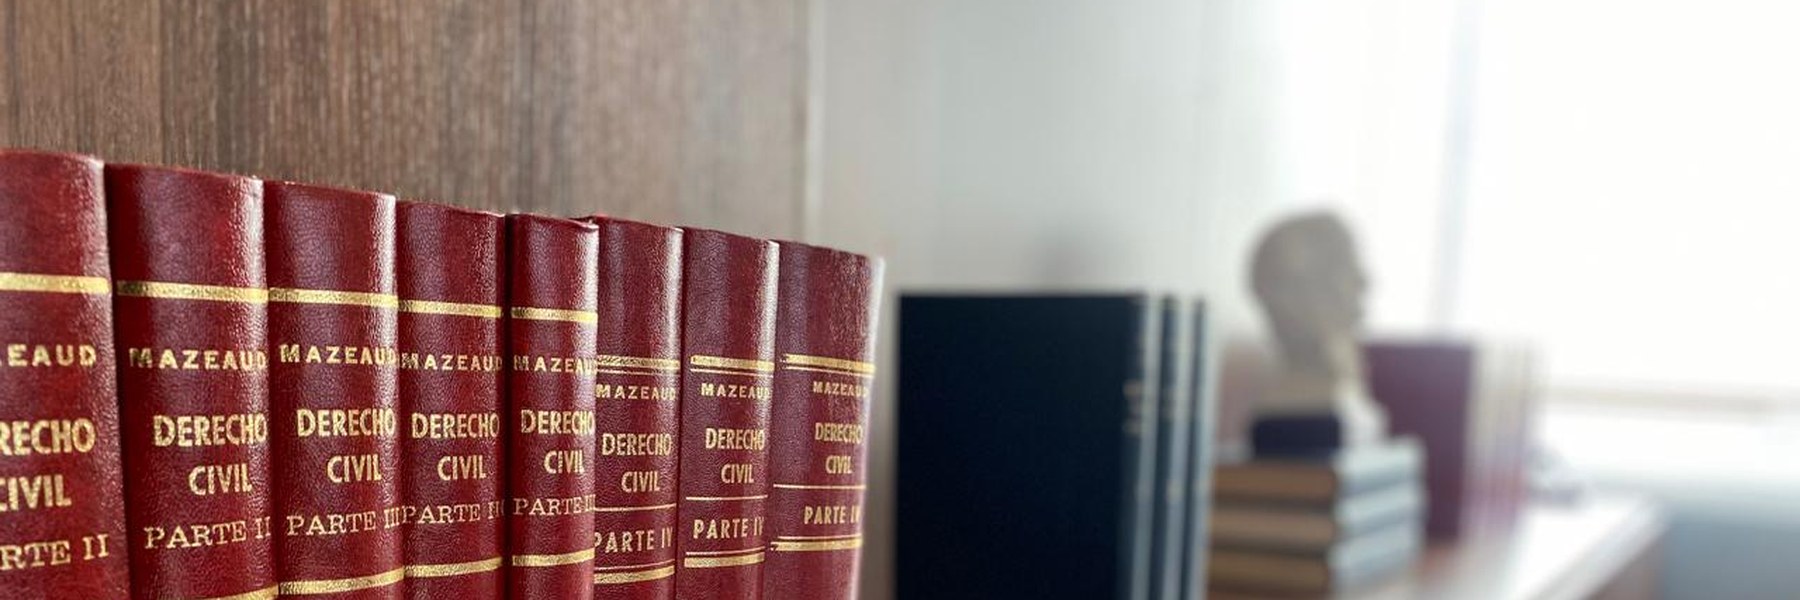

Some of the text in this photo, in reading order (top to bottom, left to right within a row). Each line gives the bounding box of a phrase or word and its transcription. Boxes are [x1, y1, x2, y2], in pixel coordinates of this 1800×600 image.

[0, 343, 97, 367] EAUD
[129, 347, 268, 370] MAZEAUD
[279, 344, 397, 366] MAZEAUD
[401, 351, 503, 372] MAZEAUD
[596, 383, 676, 401] MAZEAUD
[700, 382, 770, 401] MAZEAUD
[813, 381, 869, 398] MAZEAUD
[153, 413, 268, 447] DERECHO
[297, 408, 396, 437] DERECHO
[411, 413, 500, 439] DERECHO
[521, 409, 596, 435] DERECHO
[815, 422, 864, 444] DERECHO
[602, 433, 672, 455] DERECHO
[705, 427, 765, 451] DERECHO
[326, 455, 382, 484] CIVIL
[437, 454, 487, 481] CIVIL
[543, 450, 585, 474] CIVIL
[825, 455, 853, 476] CIVIL
[188, 464, 252, 496] CIVIL
[621, 471, 660, 492] CIVIL
[720, 464, 755, 484] CIVIL
[402, 502, 480, 525] PARTE
[513, 496, 581, 516] PARTE
[804, 505, 847, 525] PARTE
[286, 507, 400, 536] PARTE III
[693, 518, 748, 539] PARTE
[144, 520, 247, 549] PARTE
[594, 528, 655, 553] PARTE
[82, 533, 110, 561] II
